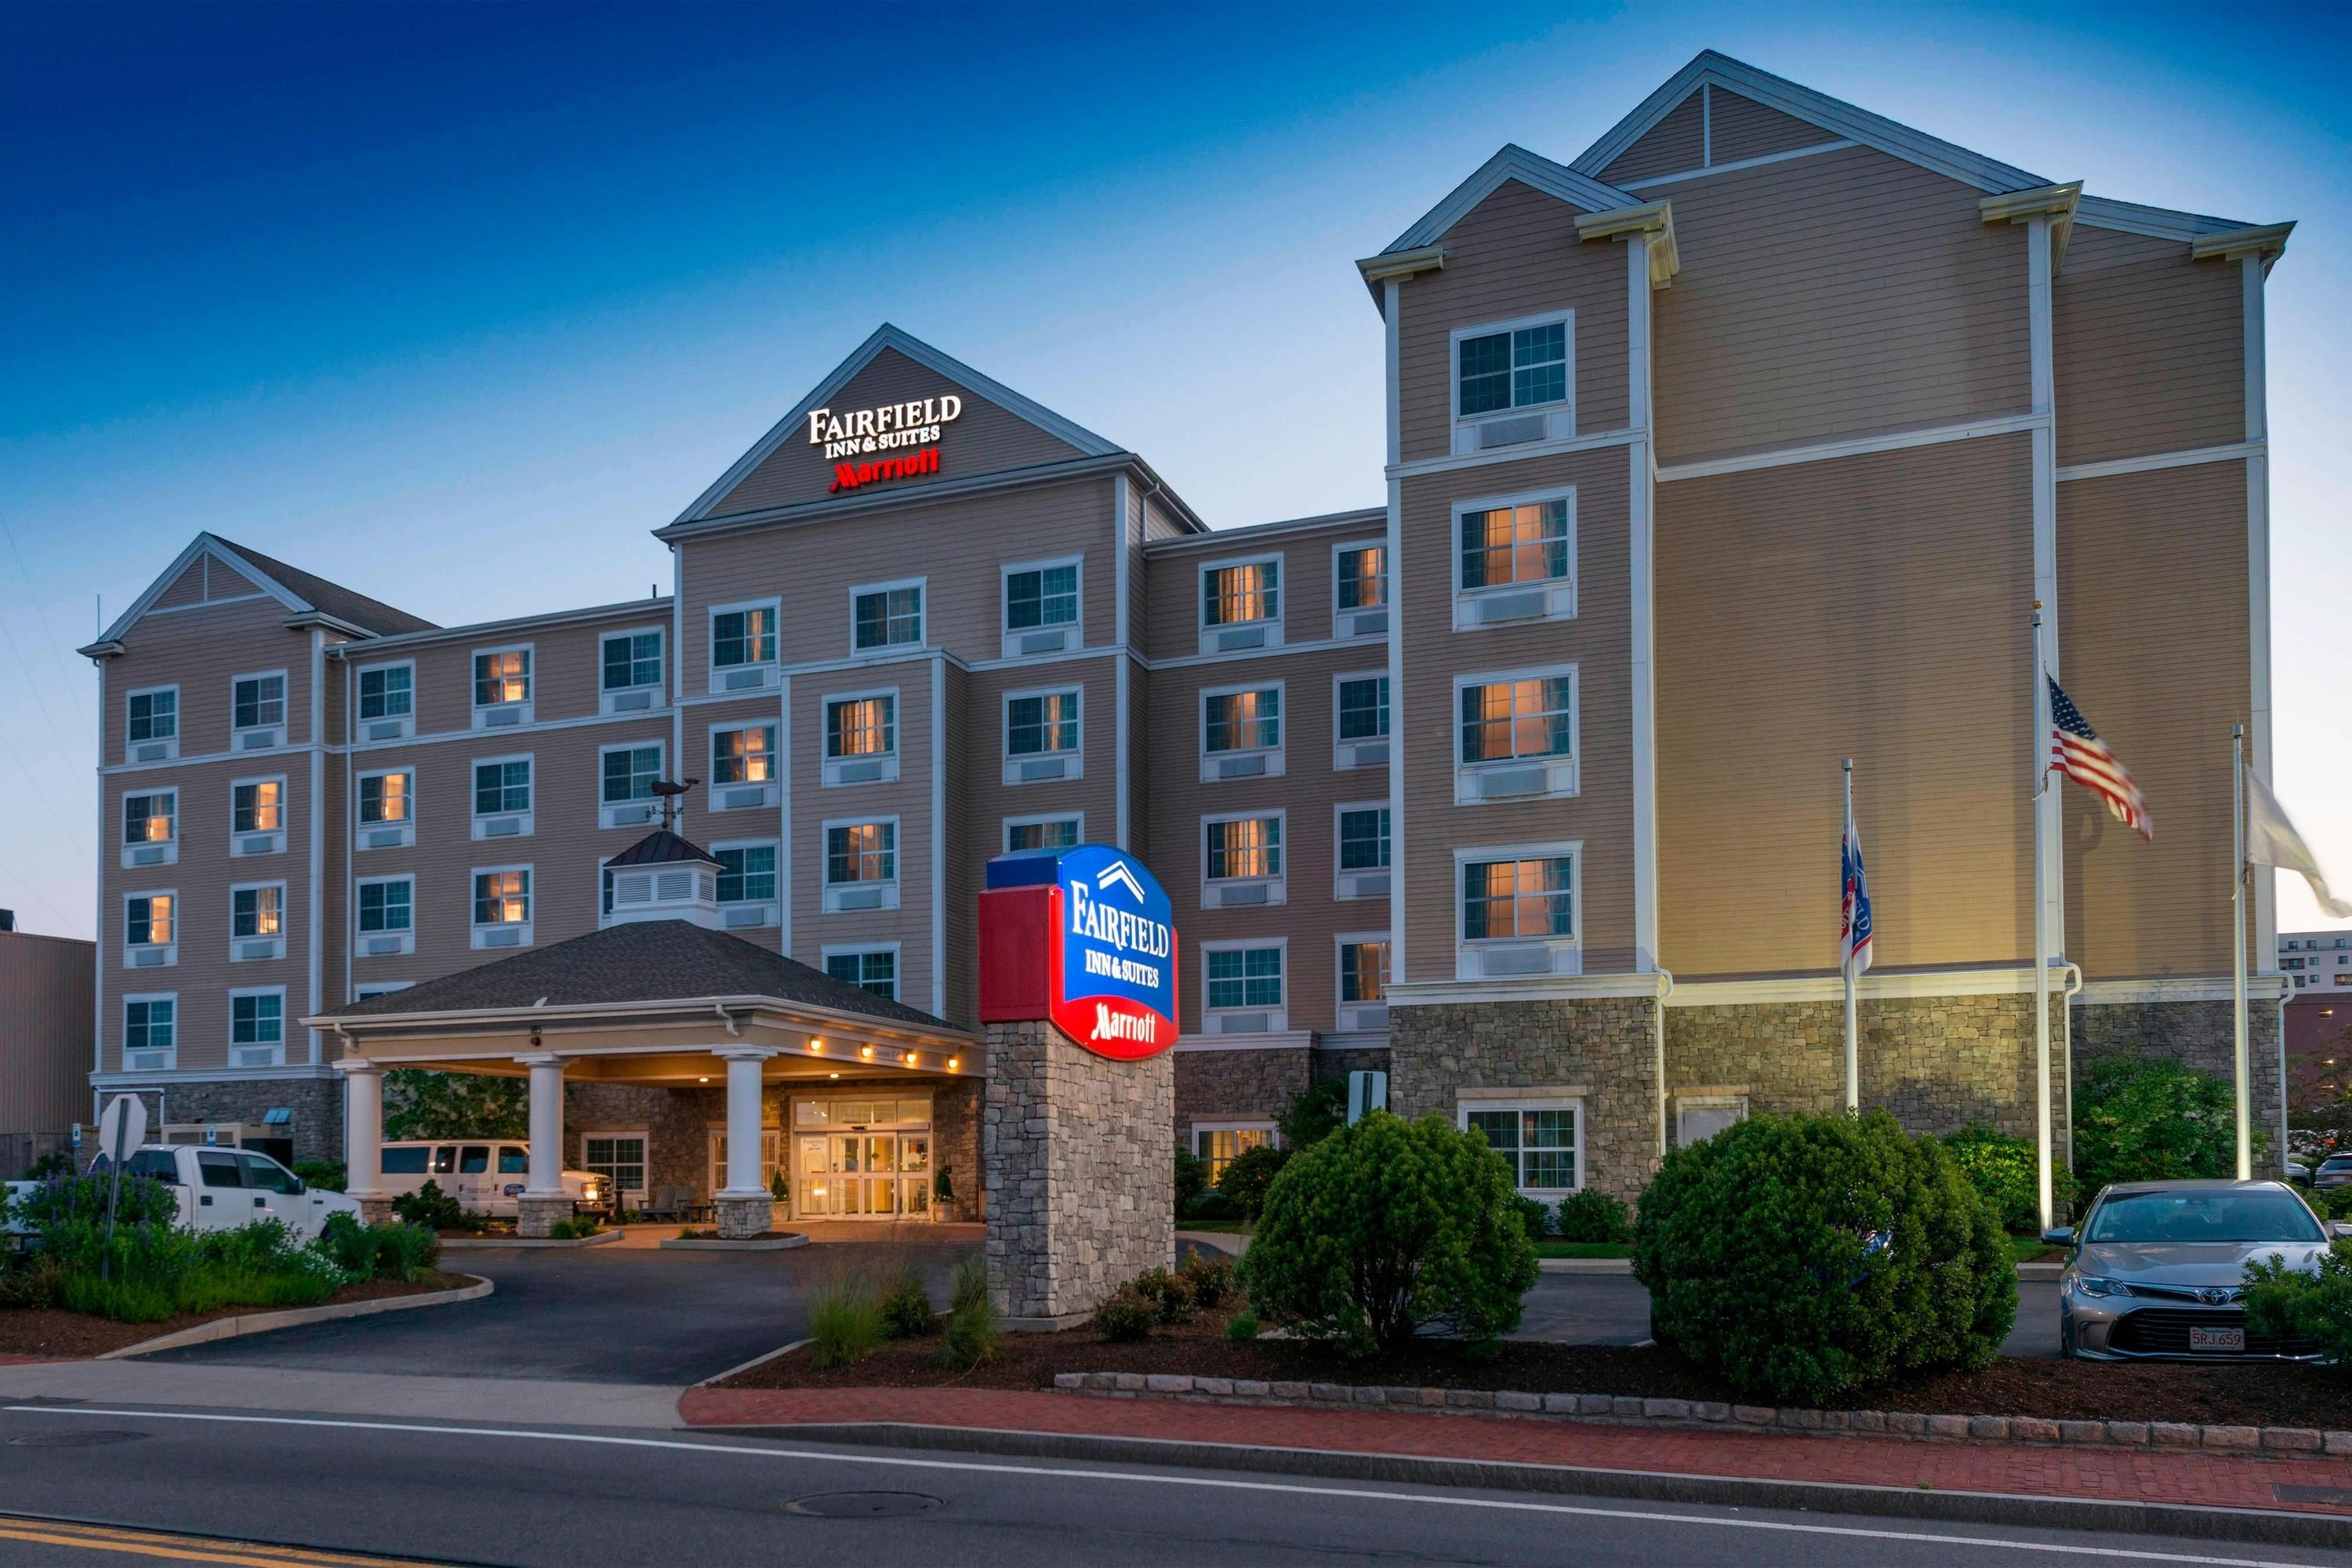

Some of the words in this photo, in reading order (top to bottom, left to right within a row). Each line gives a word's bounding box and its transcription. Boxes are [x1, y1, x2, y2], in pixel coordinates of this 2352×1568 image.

[808, 395, 961, 445] FAIRFIELD
[825, 438, 861, 459] INN
[862, 437, 877, 453] &
[878, 425, 940, 449] SUITES
[828, 448, 939, 494] Marriott
[1070, 880, 1169, 958] FAIRFIELD
[1085, 949, 1112, 977] INN
[1122, 958, 1159, 989] SUITES
[1091, 1003, 1156, 1044] Marriott
[2193, 1334, 2216, 1345] 5RJ
[2219, 1334, 2241, 1345] 659
